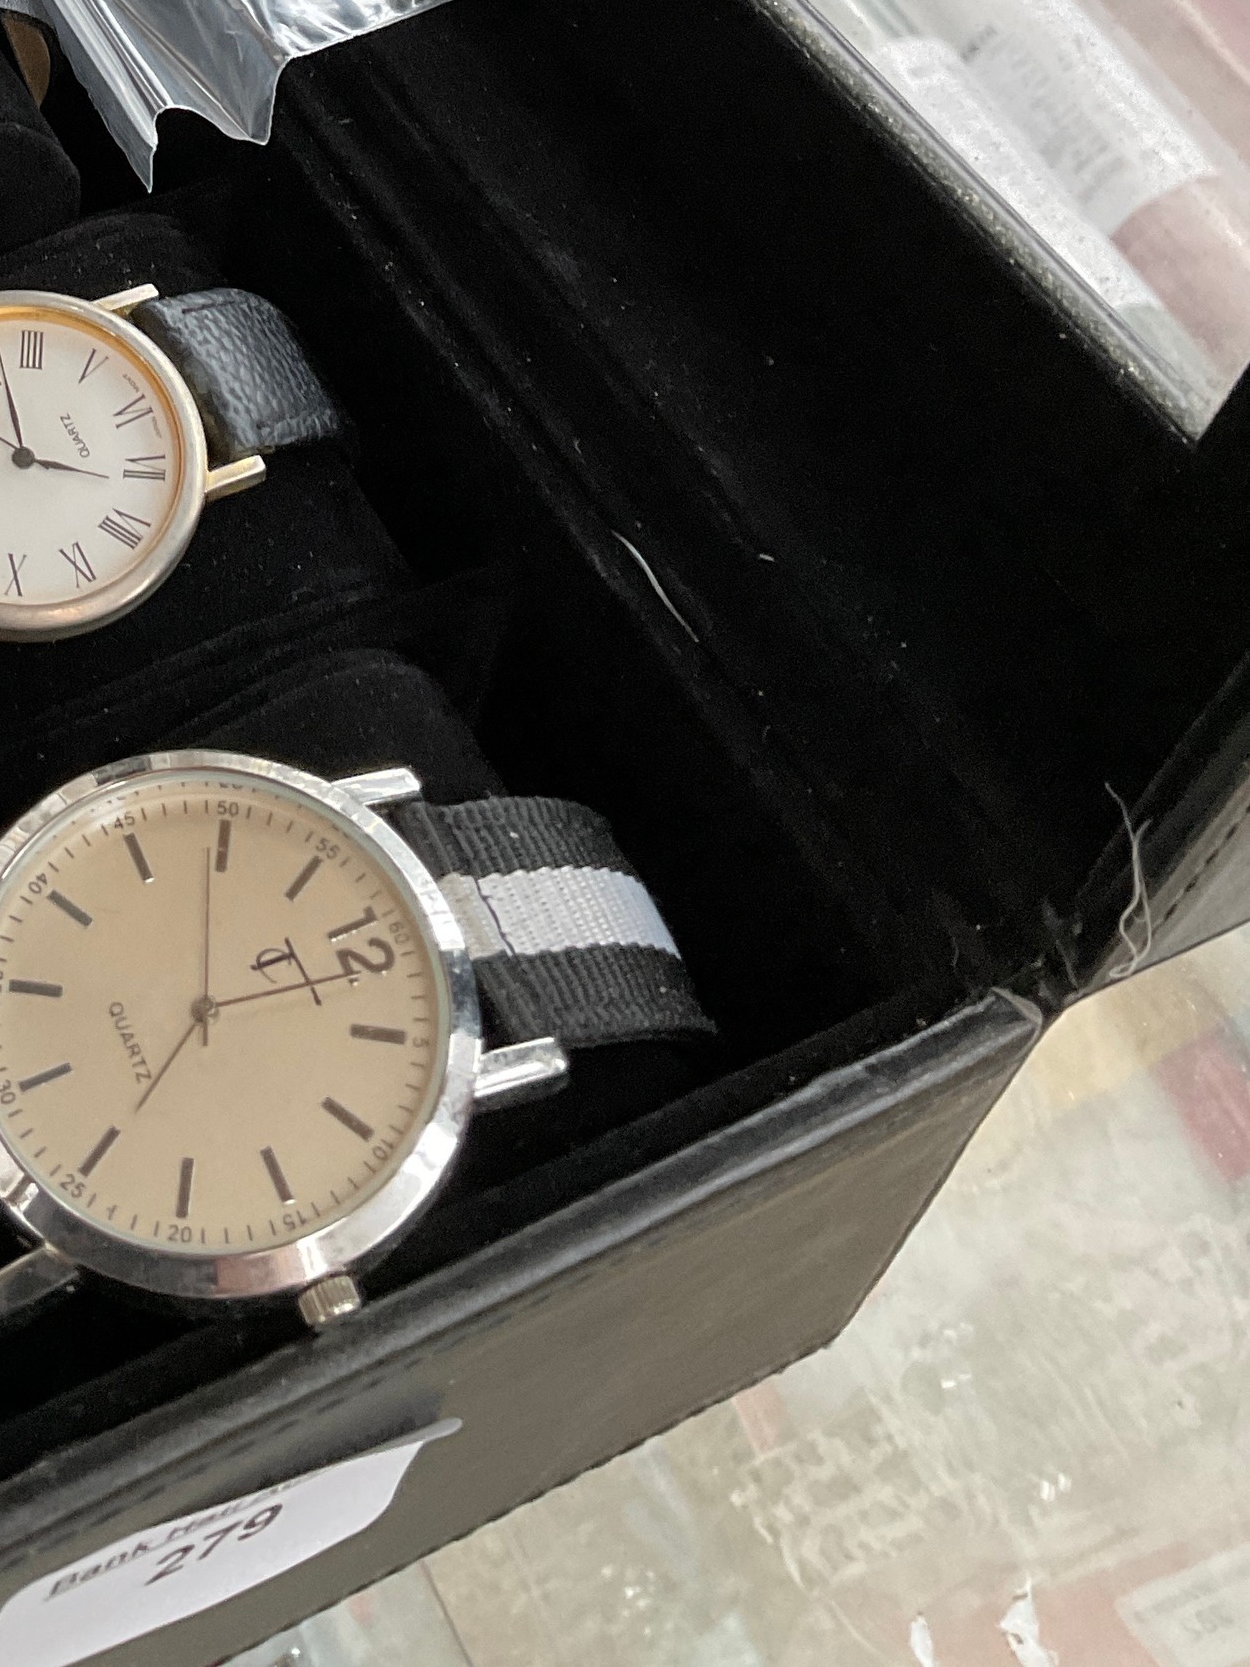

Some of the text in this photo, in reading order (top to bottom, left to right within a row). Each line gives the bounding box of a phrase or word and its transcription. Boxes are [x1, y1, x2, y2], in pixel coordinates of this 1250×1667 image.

[78, 348, 110, 384] V
[59, 412, 91, 459] QUARTZ
[3, 552, 28, 598] X
[112, 809, 137, 830] 45
[217, 801, 240, 817] 50
[315, 836, 340, 860] 55
[27, 870, 50, 897] 40
[327, 905, 396, 987] 12
[387, 921, 410, 946] 60
[107, 1000, 153, 1086] QUARTZ
[413, 1036, 426, 1050] 5
[371, 1138, 396, 1162] 10
[59, 1174, 87, 1200] 25
[168, 1224, 193, 1244] 20
[286, 1211, 310, 1232] 15
[145, 1502, 285, 1588] 279
[44, 1539, 157, 1602] Bank
